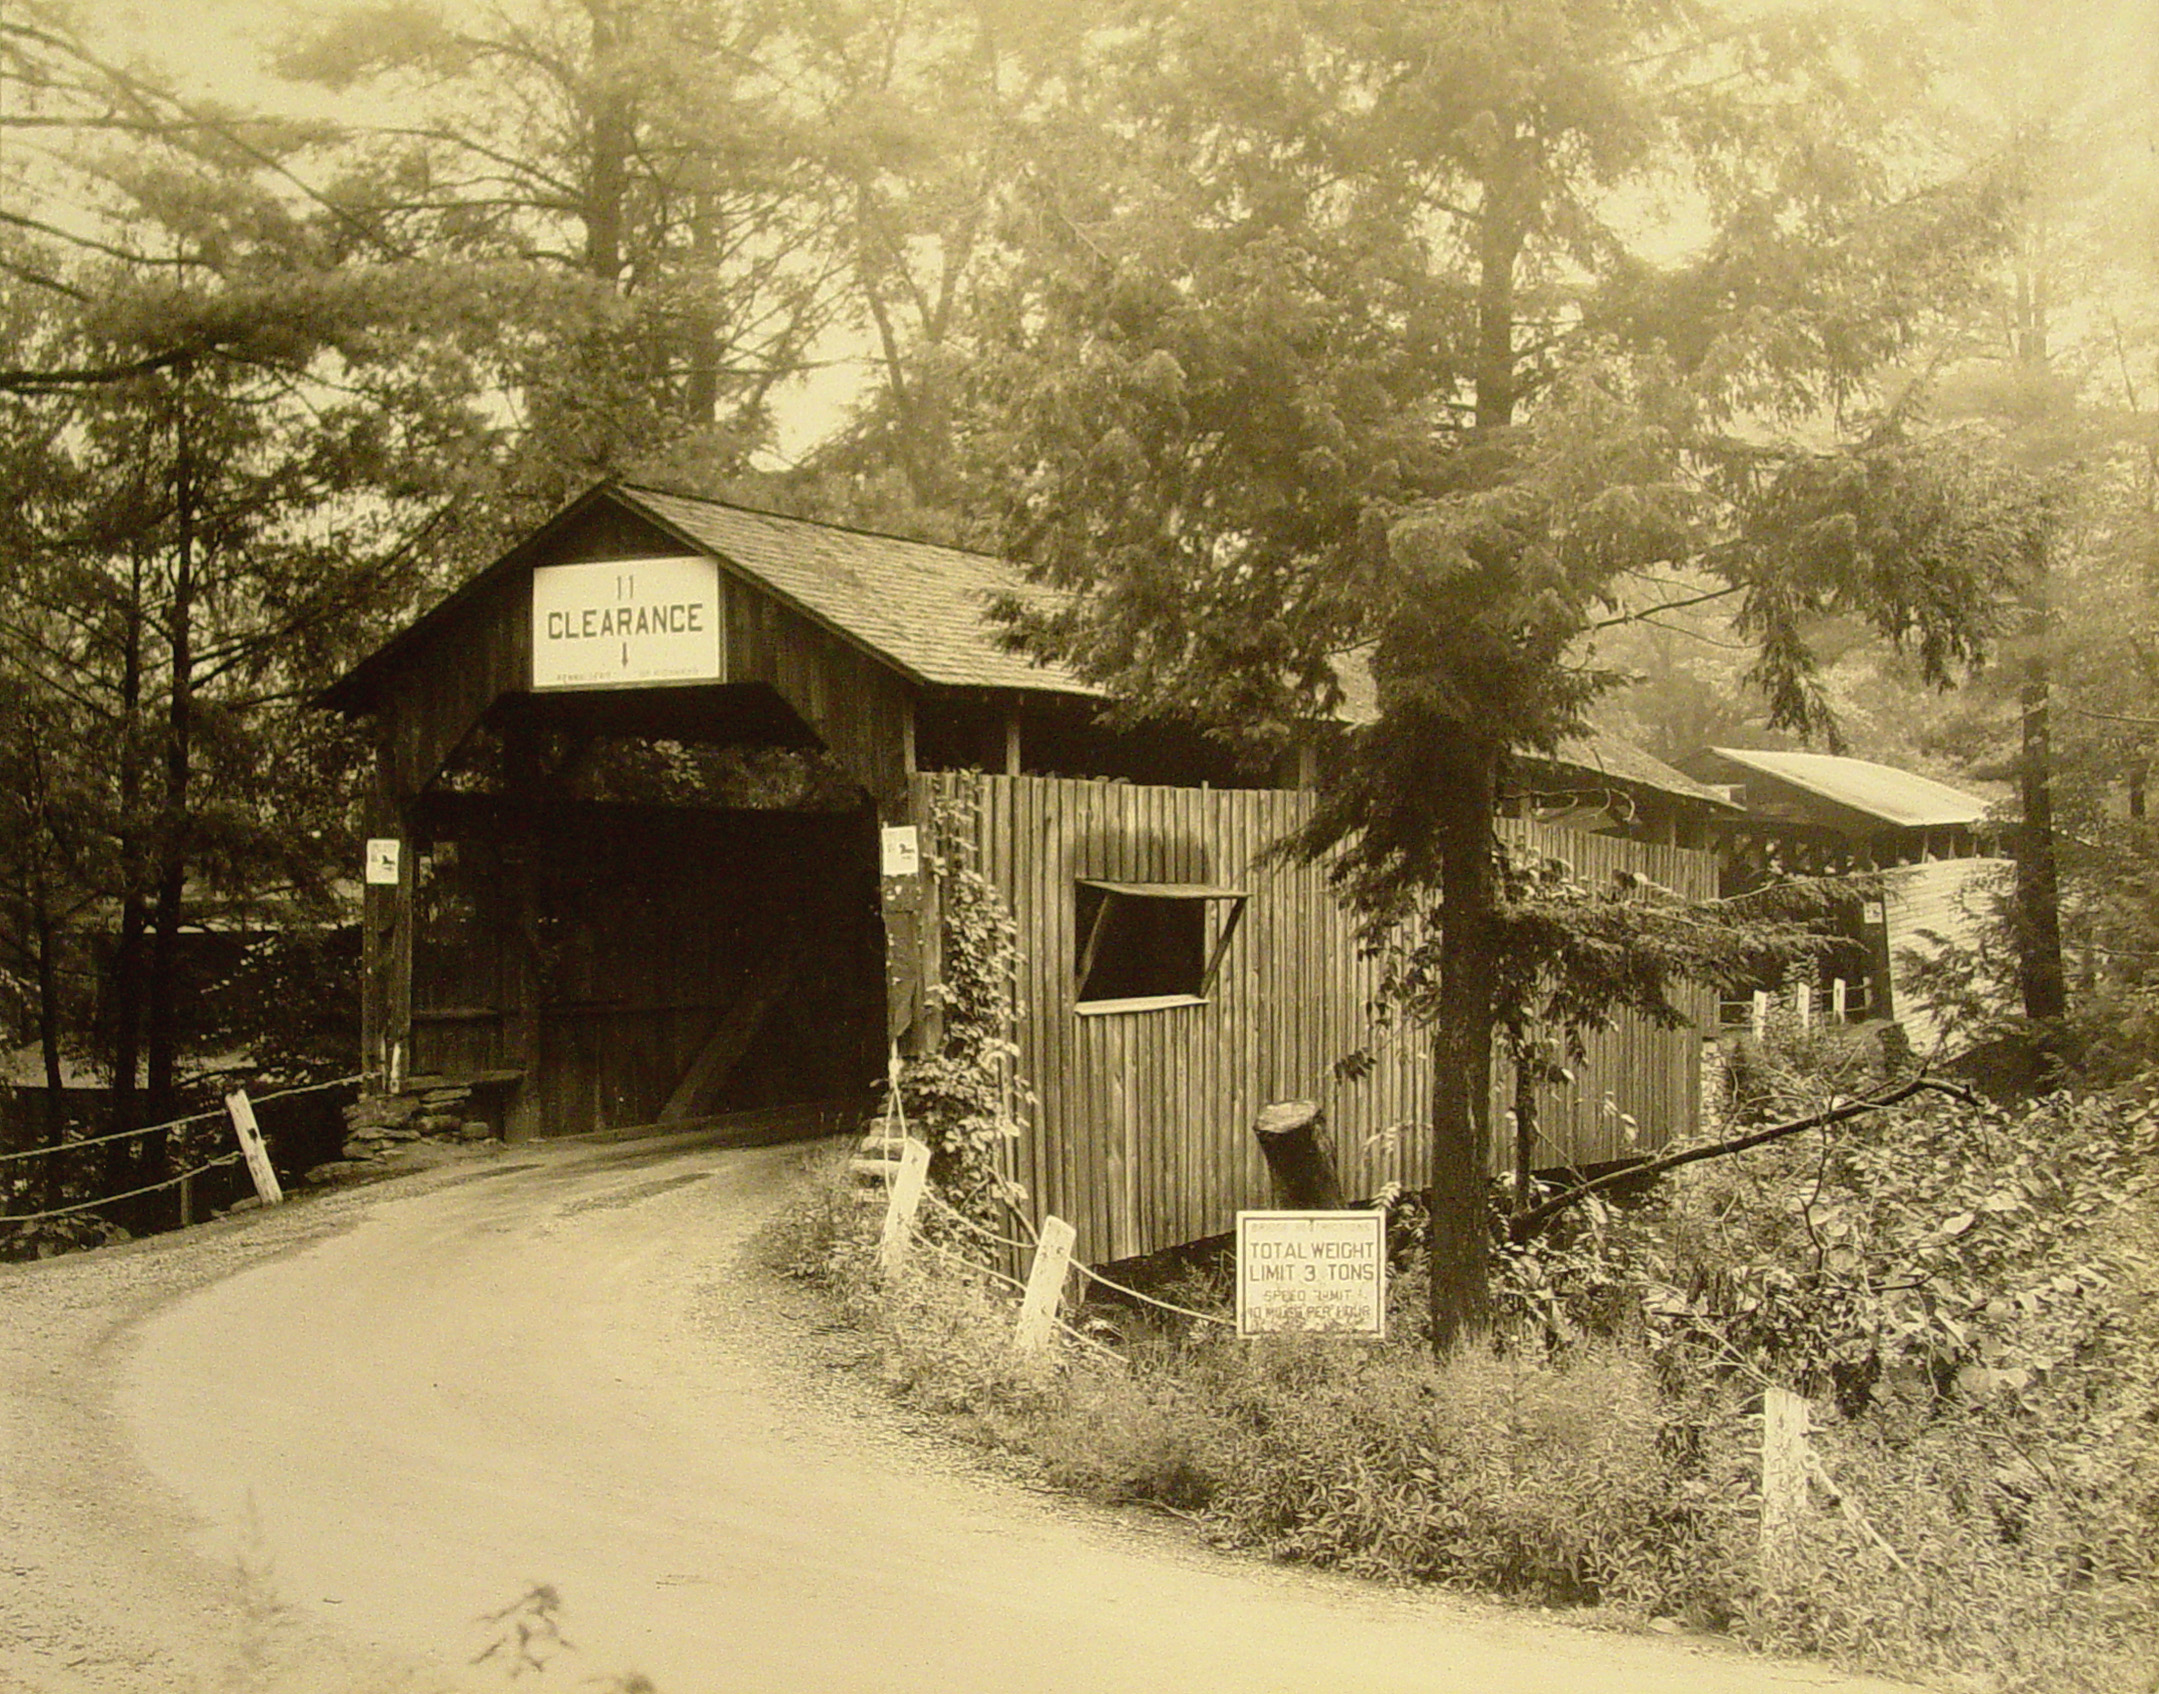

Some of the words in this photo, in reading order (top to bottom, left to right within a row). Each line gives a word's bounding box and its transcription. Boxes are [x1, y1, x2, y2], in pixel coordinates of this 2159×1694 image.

[548, 603, 703, 639] CLEARANCE
[1250, 1242, 1307, 1259] TOTAL
[1311, 1242, 1374, 1259] WEIGHT
[1250, 1264, 1294, 1281] LIMIT
[1304, 1265, 1316, 1282] 3
[1328, 1264, 1374, 1280] TONS
[1264, 1290, 1306, 1302] SPEED
[1306, 1305, 1330, 1318] PER
